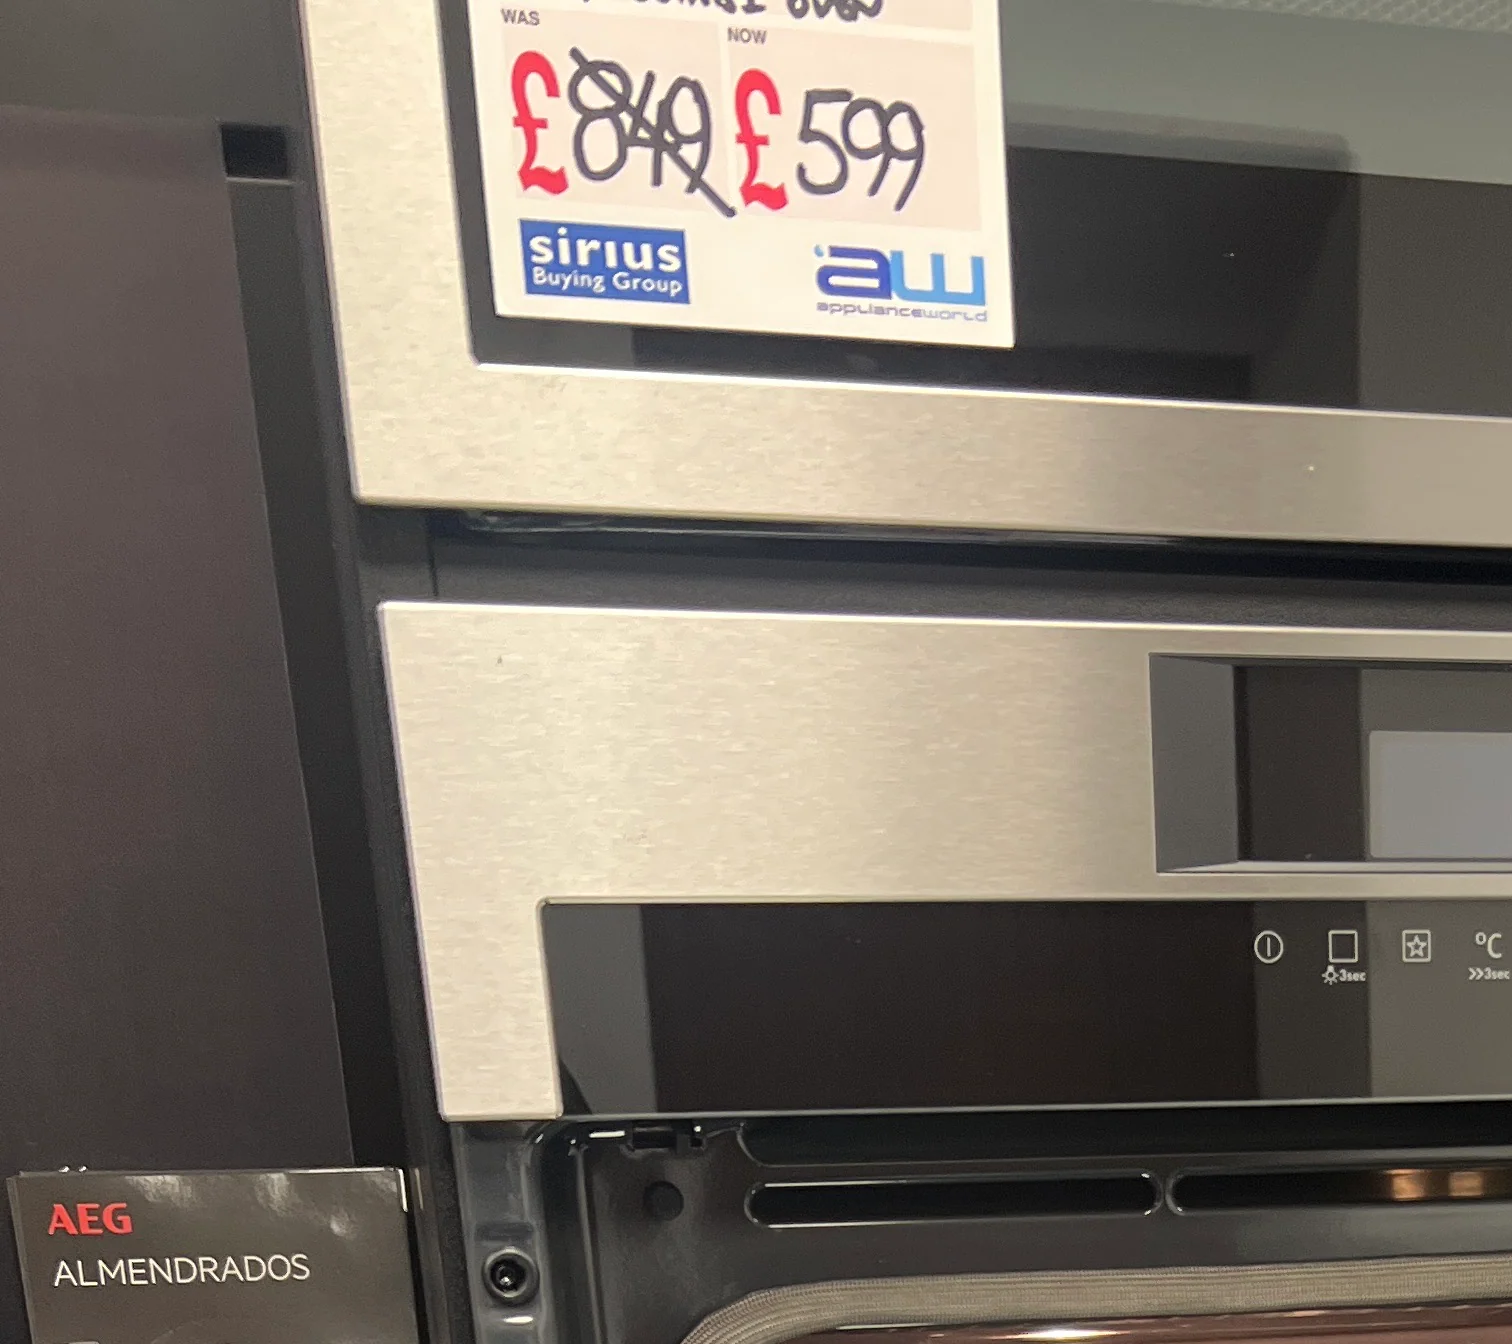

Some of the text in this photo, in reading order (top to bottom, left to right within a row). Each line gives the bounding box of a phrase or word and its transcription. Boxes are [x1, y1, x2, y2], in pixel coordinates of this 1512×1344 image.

[500, 8, 540, 27] WAS
[727, 26, 767, 45] NOW
[734, 67, 925, 211] £599
[529, 227, 683, 273] sirius
[532, 267, 683, 298] Buying Group
[816, 301, 988, 322] applianceworld
[48, 1201, 134, 1236] AEG
[53, 1253, 312, 1288] ALMENDRADOS
